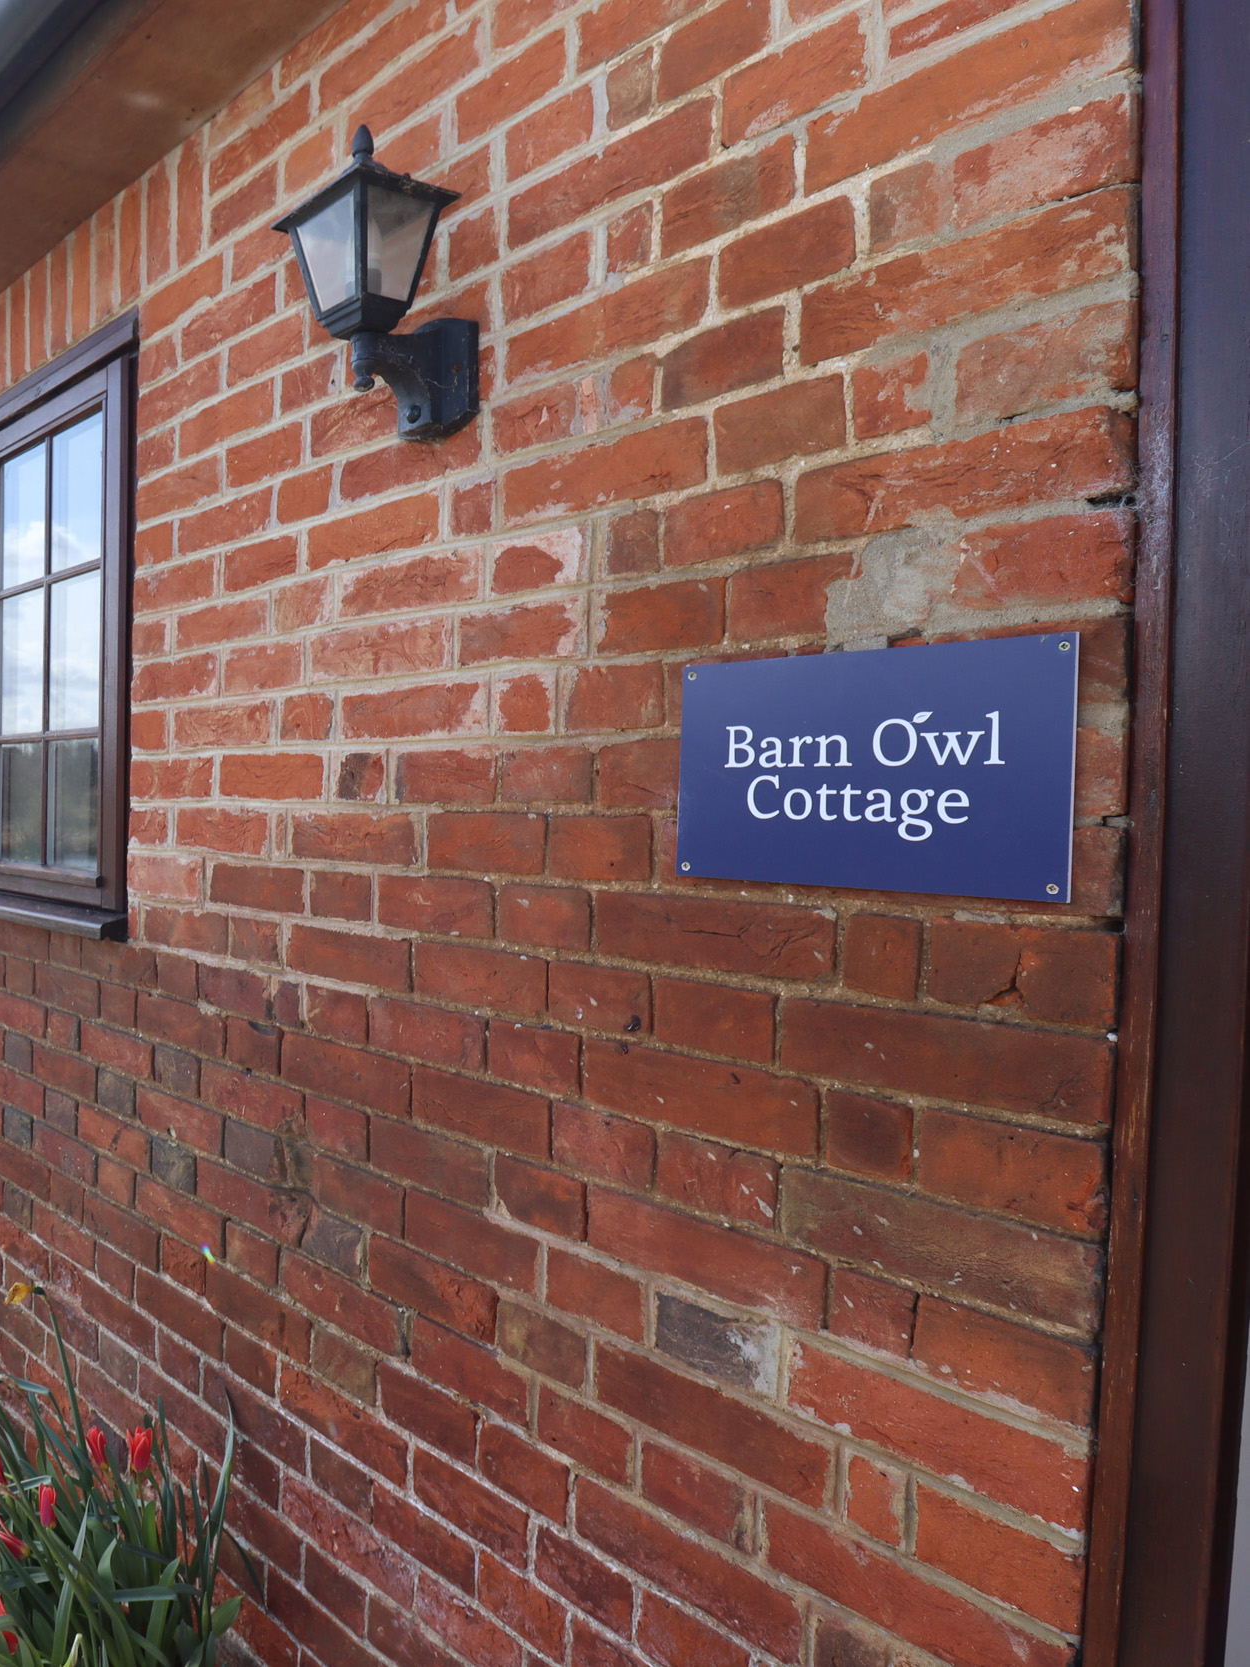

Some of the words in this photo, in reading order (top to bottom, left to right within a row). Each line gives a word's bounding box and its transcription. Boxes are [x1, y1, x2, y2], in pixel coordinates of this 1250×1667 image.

[724, 725, 853, 768] Barn
[872, 710, 1006, 767] Owl
[746, 774, 970, 842] Cottage
